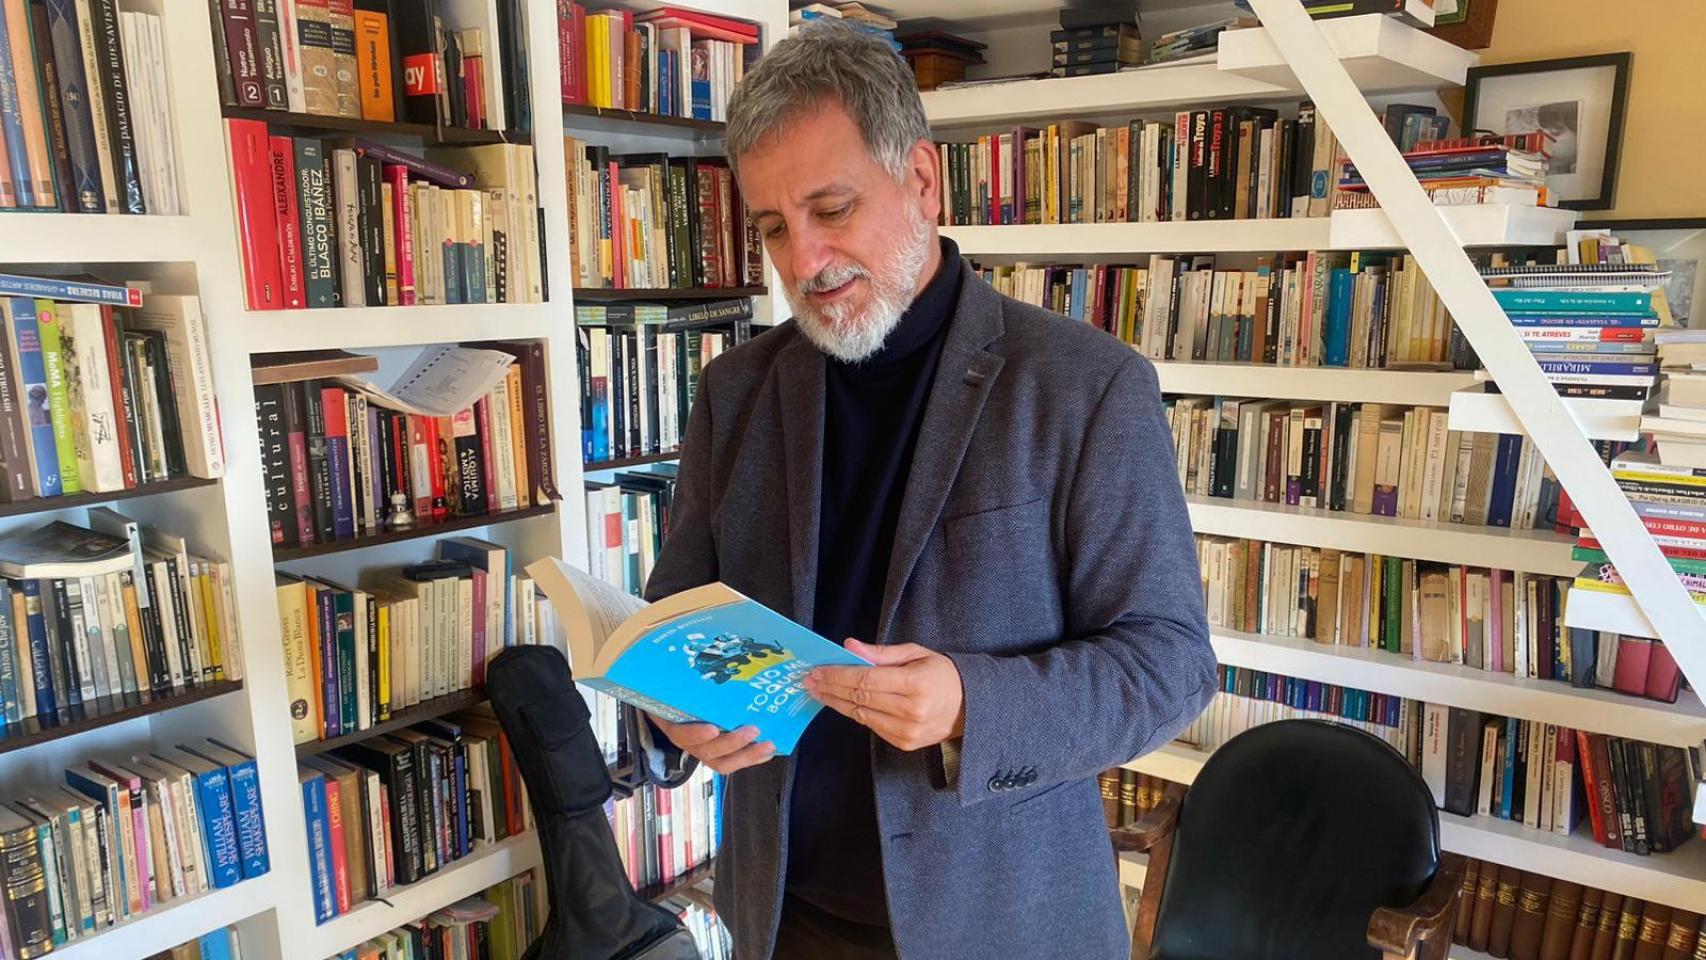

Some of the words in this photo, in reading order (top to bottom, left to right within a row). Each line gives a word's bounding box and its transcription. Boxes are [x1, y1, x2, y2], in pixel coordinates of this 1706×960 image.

[239, 50, 248, 77] Nuevo
[244, 28, 257, 77] Testamento
[264, 48, 274, 80] Antiguo
[272, 31, 285, 80] Testamento
[113, 71, 122, 90] DE
[249, 85, 259, 99] 2
[272, 89, 281, 102] 1
[115, 91, 130, 143] PALACIO
[1180, 114, 1188, 140] LUCIFER
[1194, 113, 1206, 142] Troya
[122, 143, 131, 157] EL
[1211, 123, 1222, 150] Troya
[276, 151, 289, 216] ALEIXANDRE
[311, 169, 325, 220] IBÁÑEZ
[285, 223, 296, 262] CALDERÓN
[307, 236, 317, 265] ÚLTIMO
[316, 223, 331, 278] BLASCO
[290, 265, 298, 291] EMILIO
[311, 267, 318, 279] EL
[689, 309, 709, 321] LIBELO
[710, 310, 719, 319] DE
[719, 306, 741, 317] SANGRE
[47, 352, 61, 387] MoMA
[269, 400, 288, 511] cultural
[539, 437, 547, 449] LA
[466, 448, 480, 500] ALQUIMIA
[1663, 524, 1686, 532] OTRO
[281, 617, 292, 646] Graves
[291, 608, 304, 639] Blanca
[283, 649, 294, 677] Robert
[296, 666, 307, 680] La
[750, 668, 781, 690] NO
[785, 659, 810, 675] ME
[746, 670, 809, 713] TOQUE
[249, 785, 264, 857] SHAKESPEARE
[329, 792, 340, 823] CHING
[212, 818, 228, 867] WILLIAM
[219, 795, 239, 864] SHAKESPEARE
[239, 811, 255, 859] WILLIAM
